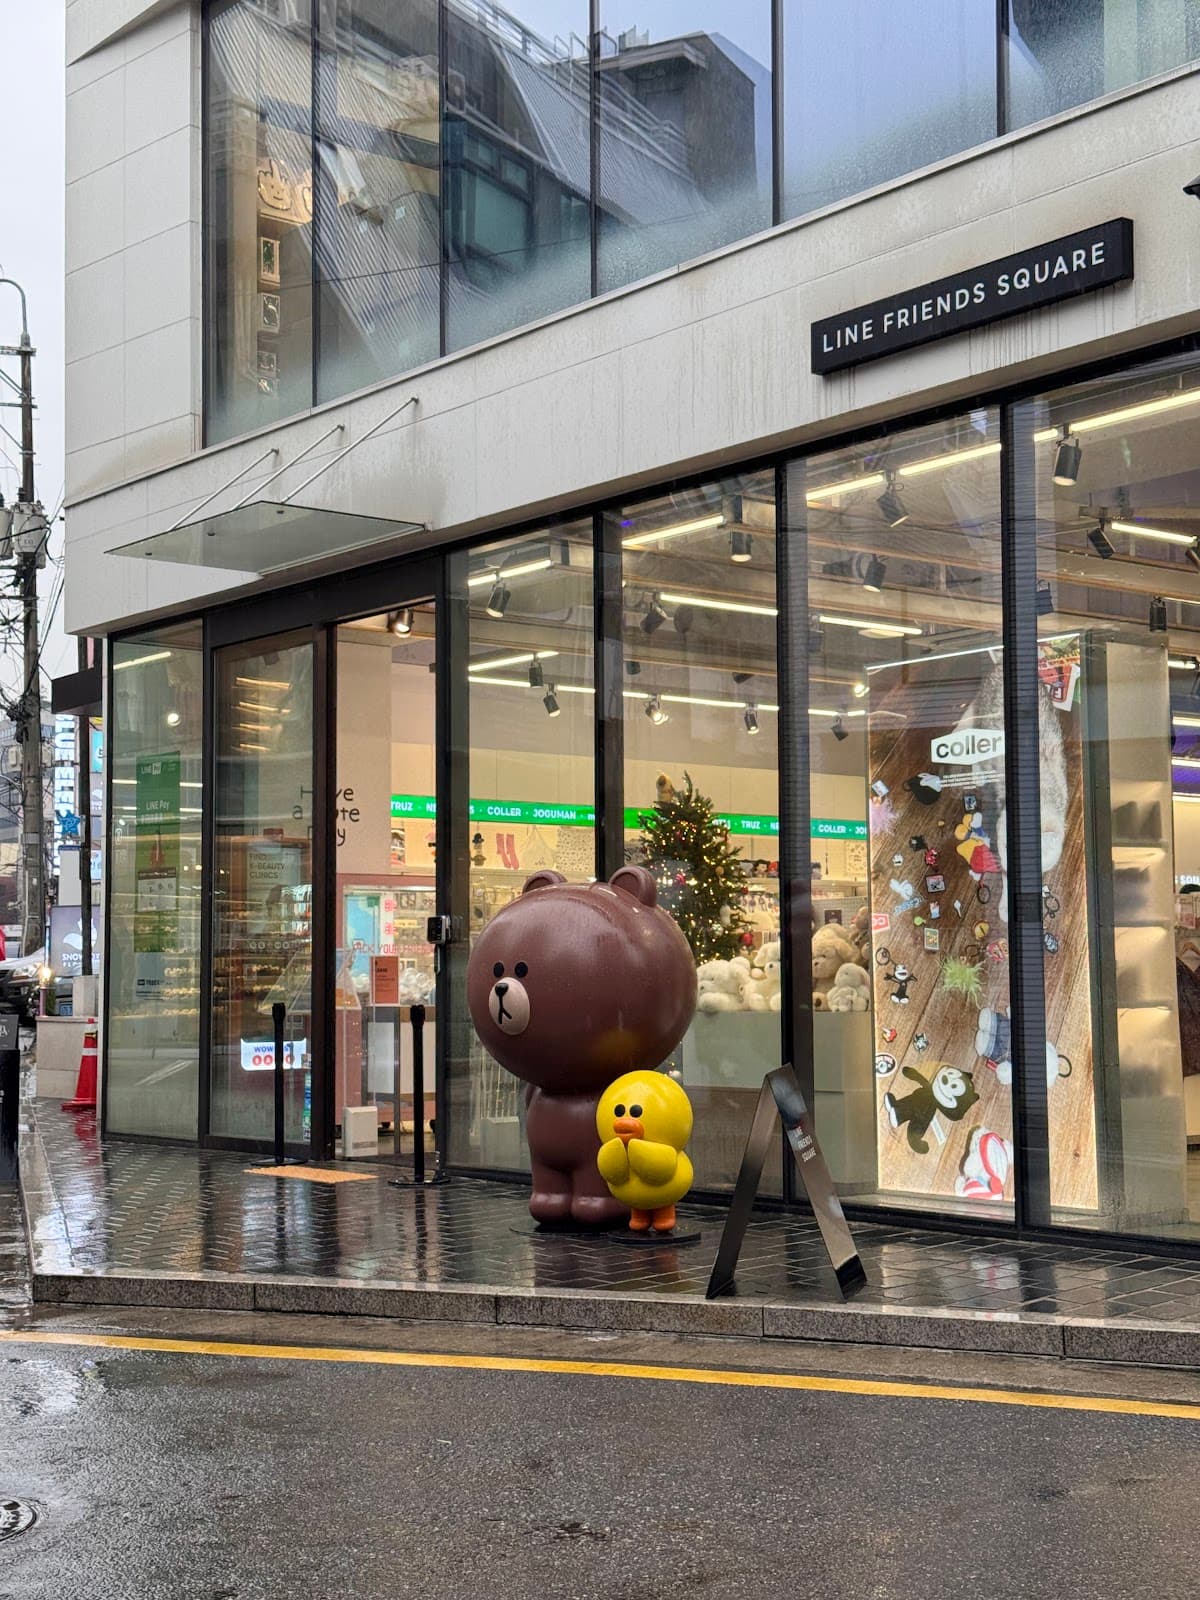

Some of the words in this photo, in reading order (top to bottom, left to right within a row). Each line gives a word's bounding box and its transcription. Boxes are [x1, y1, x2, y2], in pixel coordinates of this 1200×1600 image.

[823, 319, 874, 354] LINE
[883, 282, 986, 334] FRIENDS
[997, 241, 1106, 297] SQUARE
[936, 734, 1002, 759] coller
[292, 804, 304, 821] a
[391, 800, 414, 811] TRUZ
[486, 806, 522, 818] COLLER
[532, 808, 577, 820] JOGUMAN
[741, 819, 761, 830] TRUZ
[818, 823, 847, 834] COLLER
